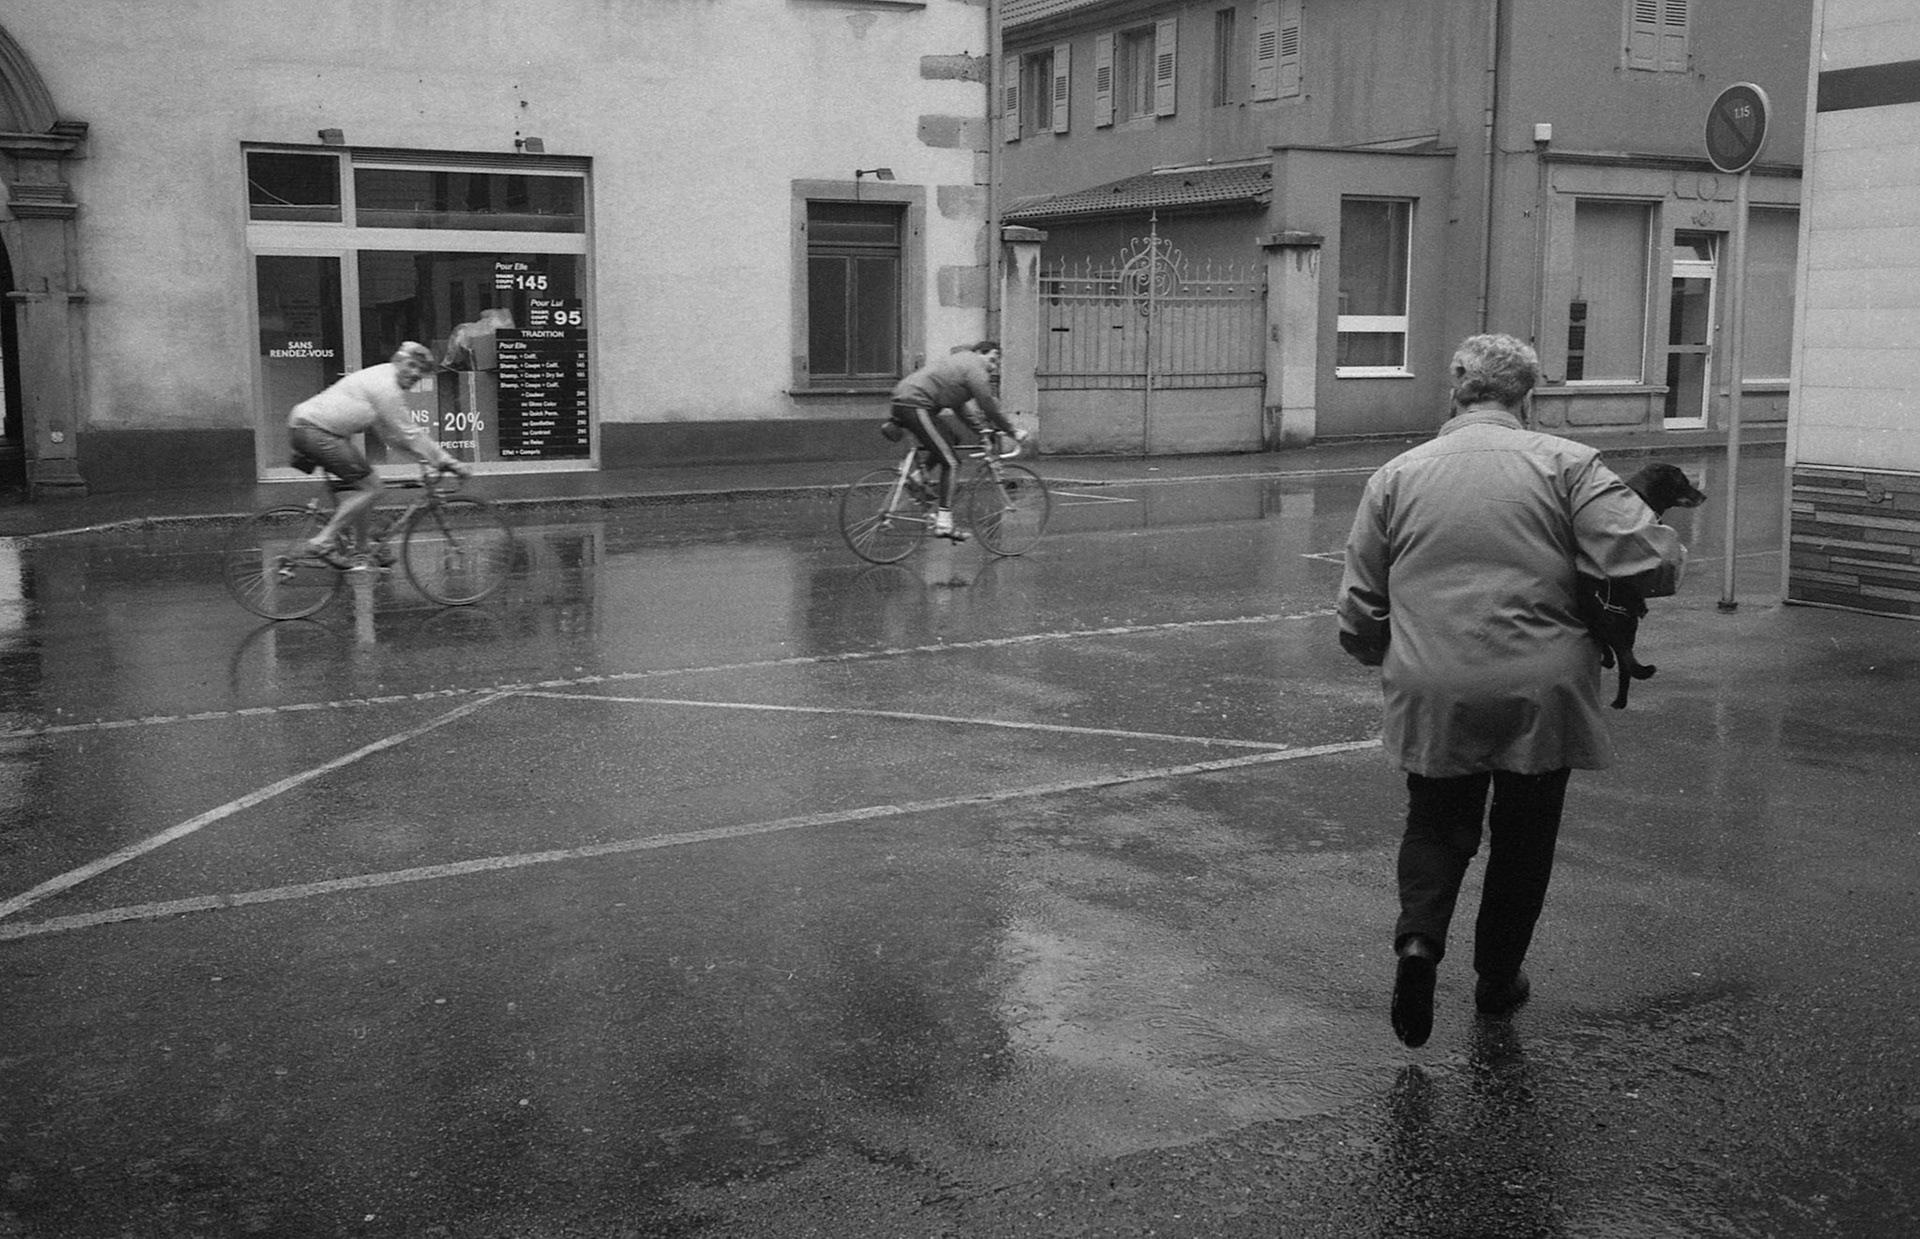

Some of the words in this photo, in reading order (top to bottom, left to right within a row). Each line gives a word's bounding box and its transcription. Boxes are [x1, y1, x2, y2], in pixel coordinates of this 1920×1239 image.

[495, 262, 513, 270] Pour
[514, 262, 528, 271] Elle
[515, 274, 548, 290] 145
[530, 299, 549, 307] Pour
[550, 299, 564, 307] Lui
[553, 310, 581, 326] 95
[521, 330, 565, 338] TRADITION
[288, 341, 313, 349] SANS
[269, 349, 335, 358] RENDEZ-VOUS
[435, 440, 476, 449] SPECTES
